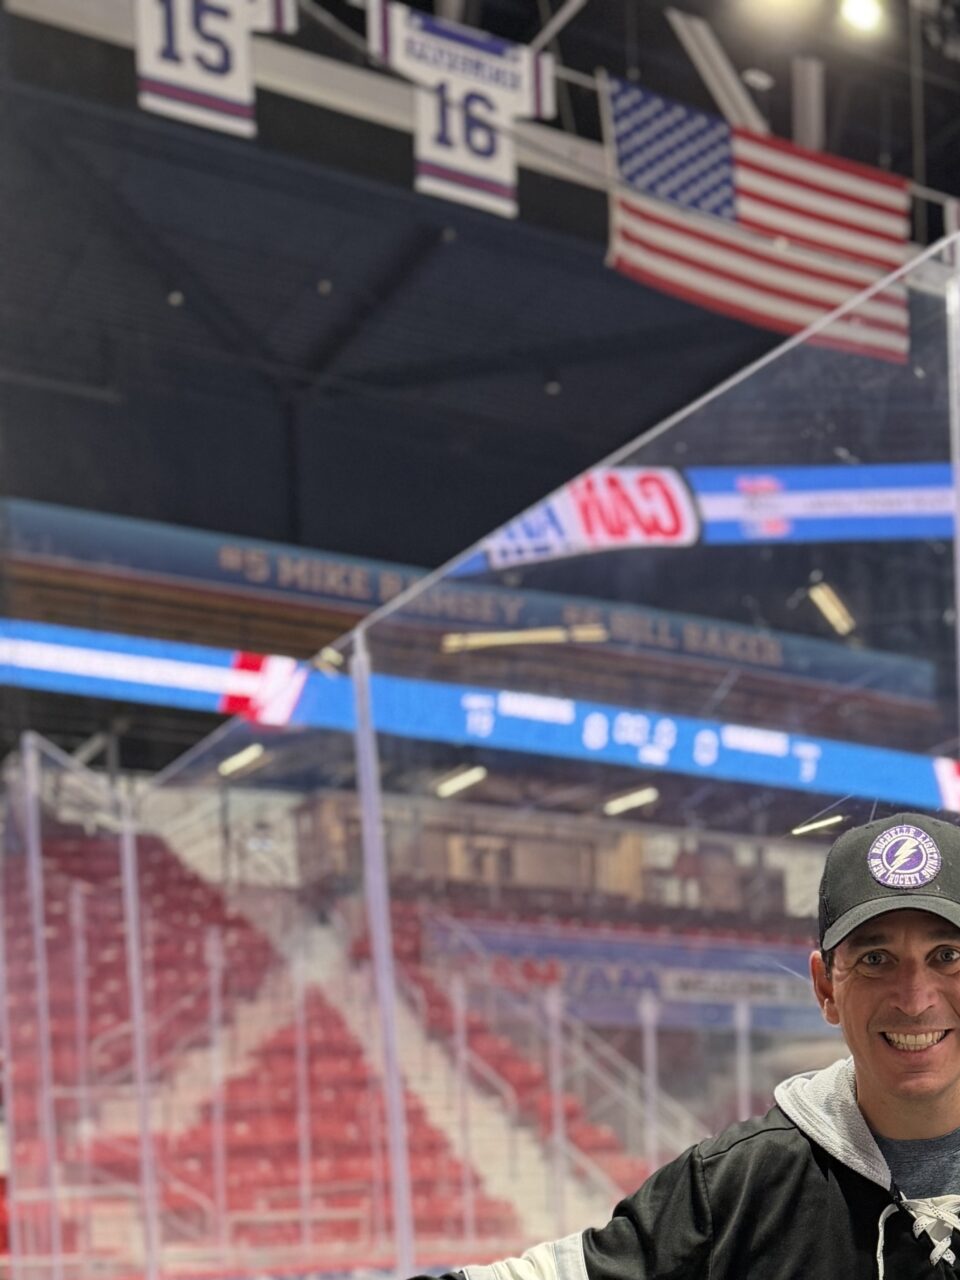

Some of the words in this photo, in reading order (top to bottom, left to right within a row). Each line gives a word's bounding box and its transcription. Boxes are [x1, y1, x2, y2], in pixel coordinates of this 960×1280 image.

[155, 0, 232, 76] 15
[435, 82, 497, 159] 16
[871, 827, 916, 855] ROCHELLE
[919, 833, 939, 878] LIGHTNING
[870, 858, 887, 878] NEW
[887, 872, 921, 885] HOCKEY
